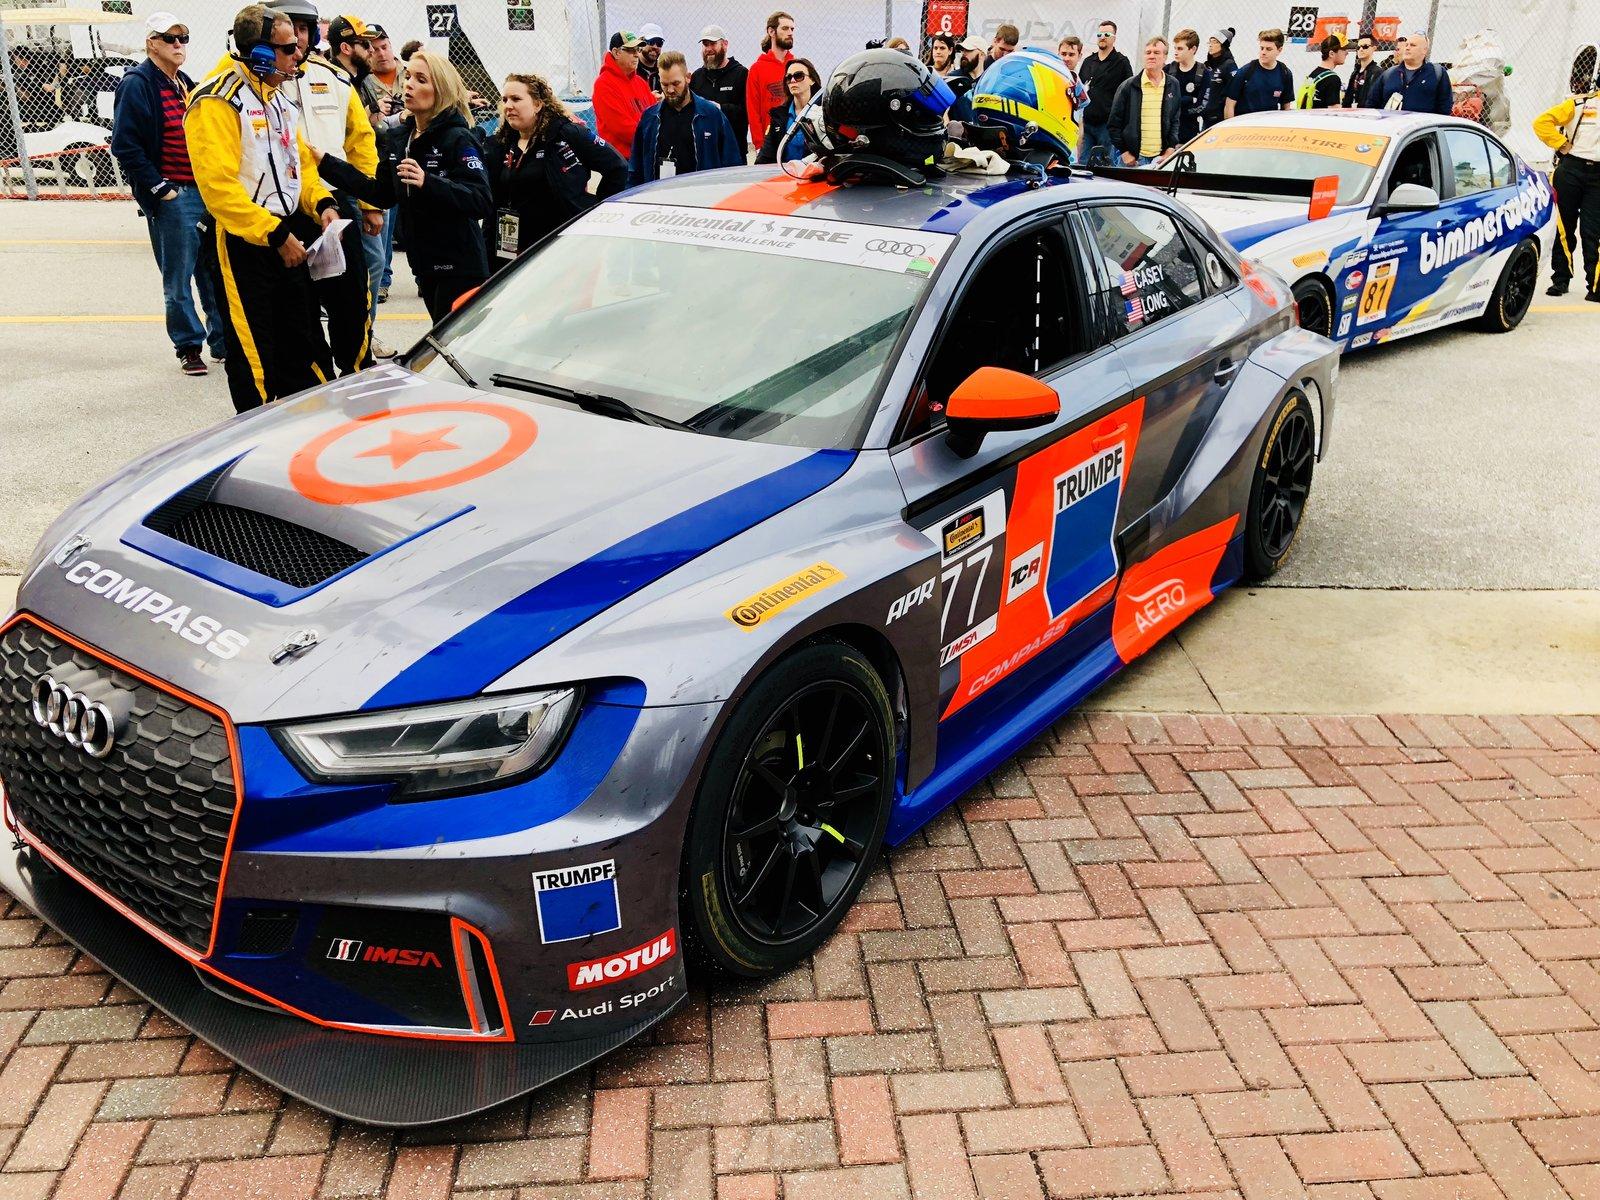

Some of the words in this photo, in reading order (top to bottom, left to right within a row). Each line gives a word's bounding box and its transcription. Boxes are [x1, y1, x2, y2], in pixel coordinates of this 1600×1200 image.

[431, 12, 455, 31] 27
[940, 14, 952, 32] 6
[1290, 13, 1316, 31] 28
[1224, 134, 1296, 144] Continental
[1311, 138, 1348, 150] TIRE
[629, 209, 755, 233] Continental
[780, 226, 853, 245] TIRE
[653, 227, 720, 241] SPORTSCAR
[720, 234, 796, 249] CHALLENGE
[1419, 171, 1551, 275] bimmerworld
[1134, 264, 1164, 289] CASEY
[1140, 291, 1168, 315] LONG
[1363, 279, 1389, 314] 81
[1056, 446, 1123, 510] TRUMPF
[949, 523, 975, 544] Continental
[1010, 556, 1041, 590] TCR
[65, 560, 250, 660] COMPASS
[731, 569, 827, 627] Continental
[885, 576, 937, 626] APR
[940, 544, 993, 644] 77
[1134, 584, 1186, 633] AERO
[949, 630, 978, 658] IMSA
[968, 618, 1068, 696] COMPASS
[536, 863, 614, 890] TRUMPF
[363, 945, 443, 968] IMSA
[575, 936, 672, 985] MOTUL
[560, 1000, 613, 1021] Audi
[619, 975, 675, 1007] Sport
